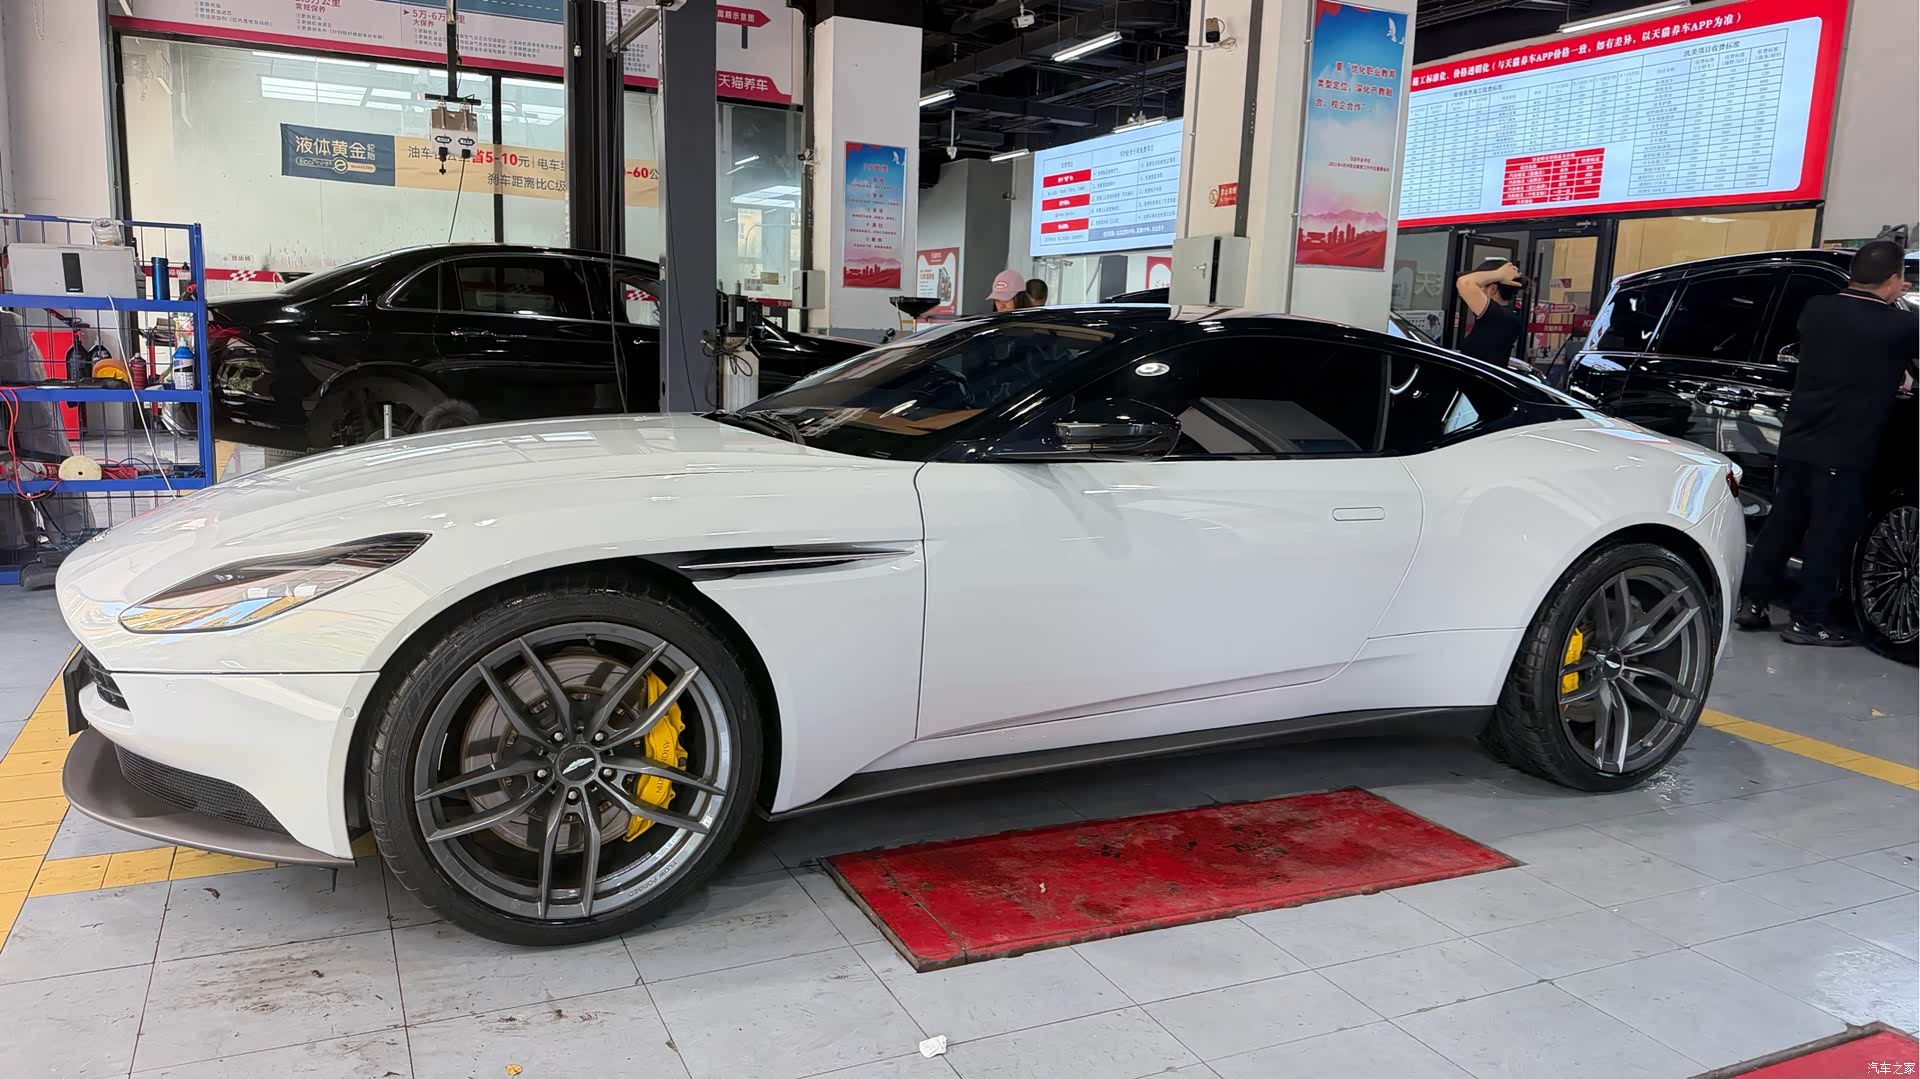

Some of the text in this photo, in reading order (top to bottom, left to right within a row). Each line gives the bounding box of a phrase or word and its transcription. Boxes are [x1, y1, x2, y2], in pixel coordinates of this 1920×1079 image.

[412, 9, 466, 25] 5万-6万里
[412, 19, 434, 28] 大保养
[718, 74, 768, 91] 天猫养车
[295, 135, 366, 160] 液体黄金
[487, 172, 567, 192] 刹车距离比C级
[659, 861, 679, 878] FLOW
[627, 877, 658, 898] FORGED
